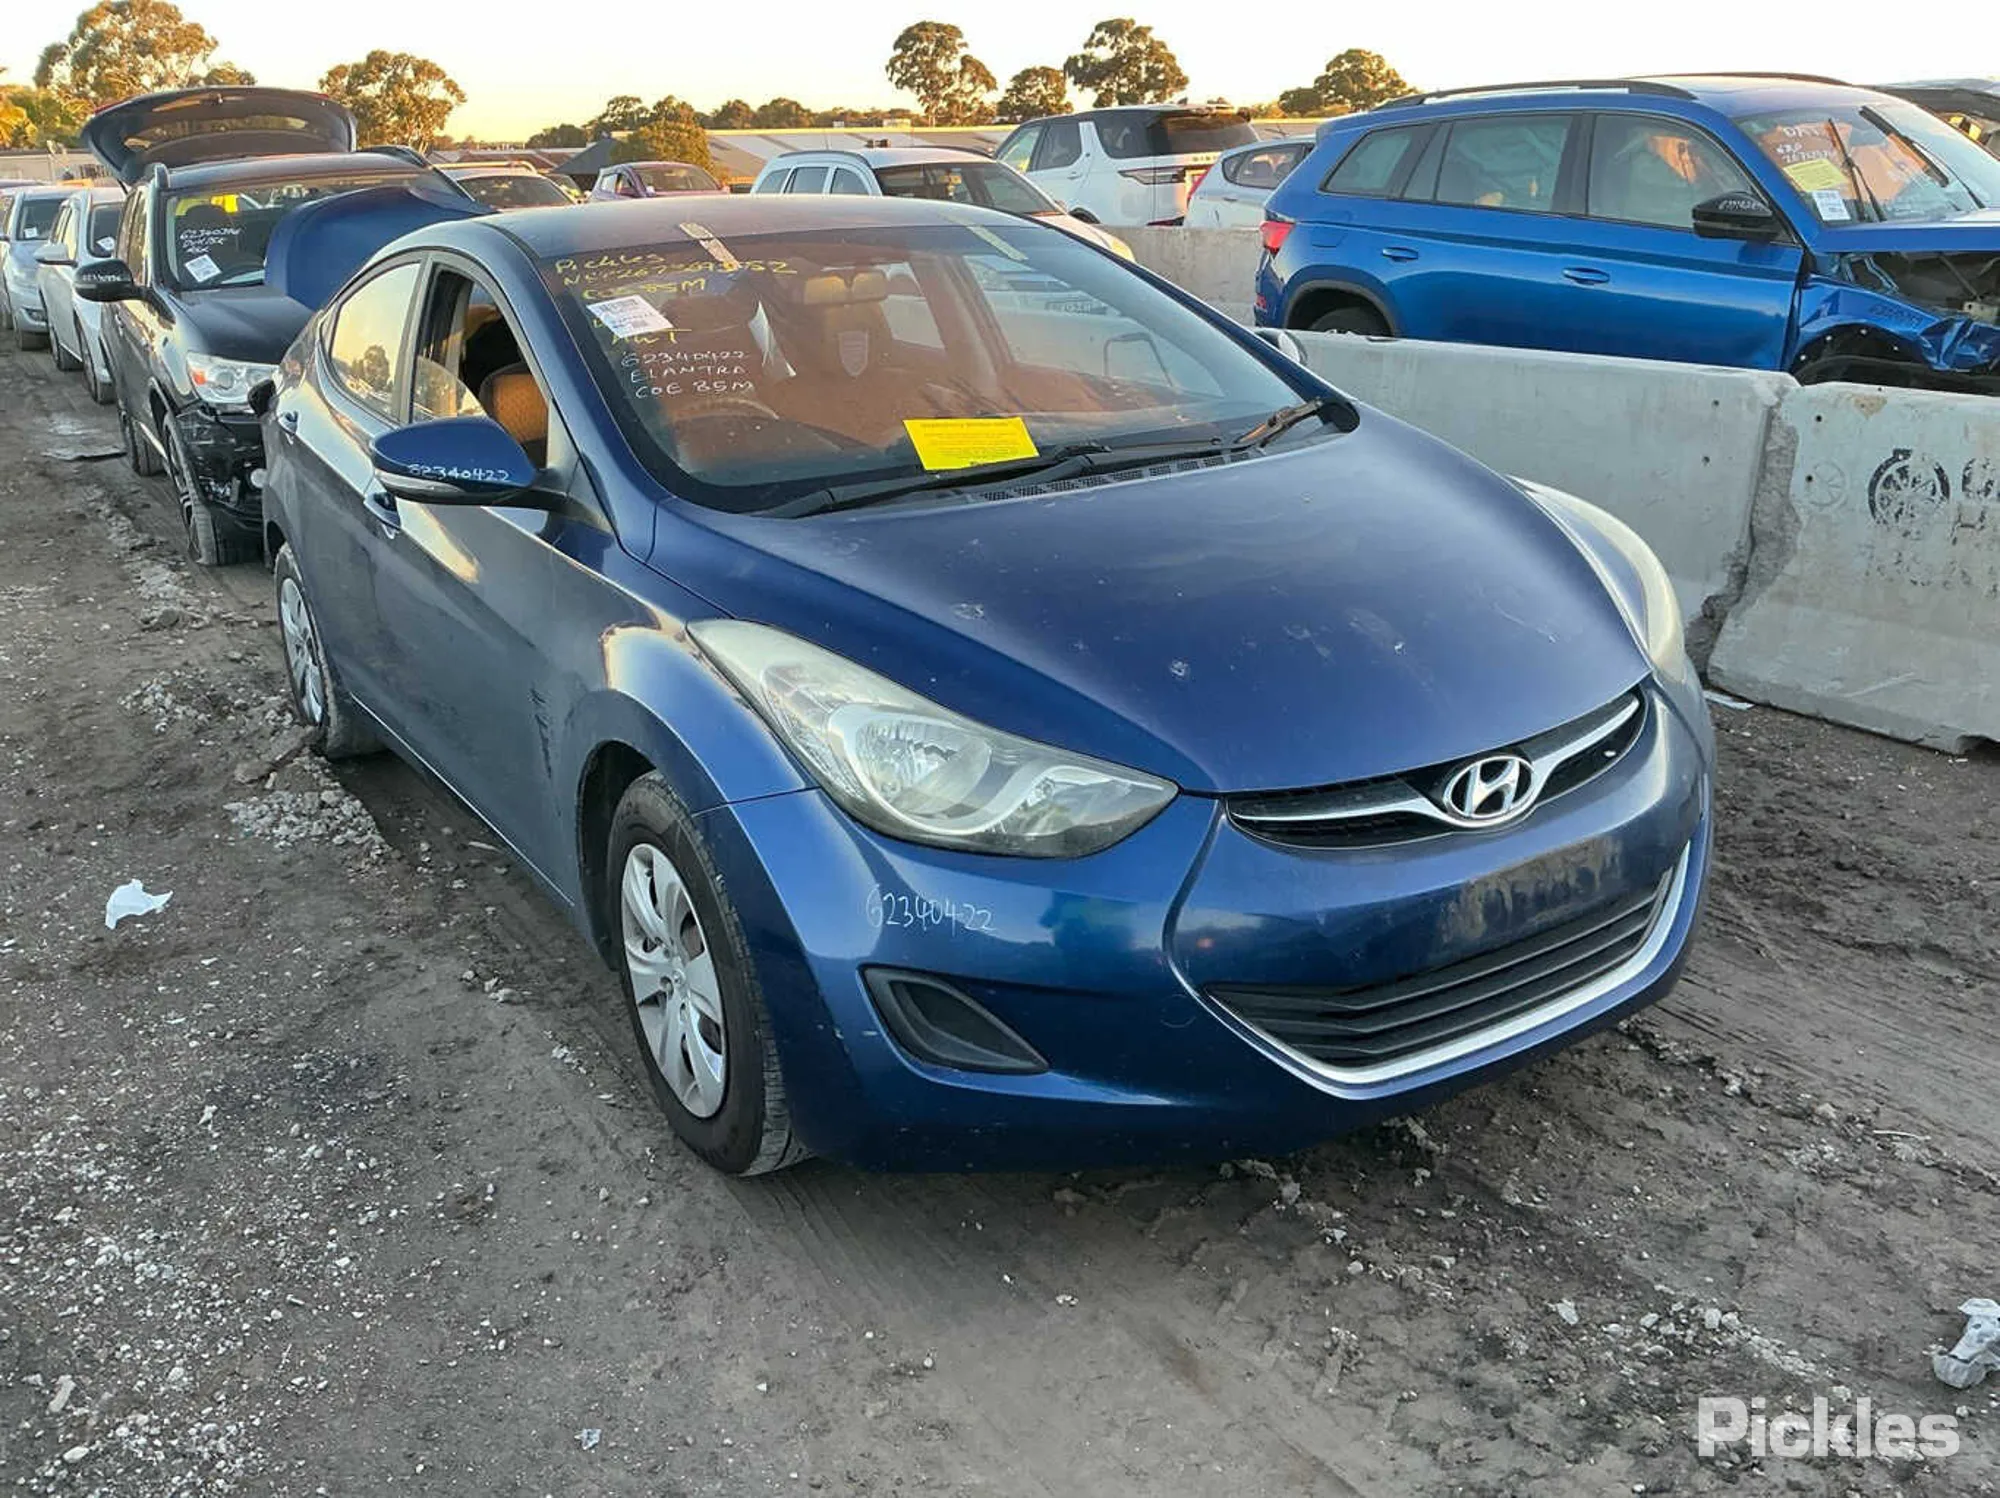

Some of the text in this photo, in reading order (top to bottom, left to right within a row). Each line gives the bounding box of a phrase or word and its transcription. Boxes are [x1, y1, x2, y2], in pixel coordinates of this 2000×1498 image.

[631, 366, 746, 383] ELANTRA
[636, 384, 682, 398] COE
[865, 883, 998, 936] 62340422
